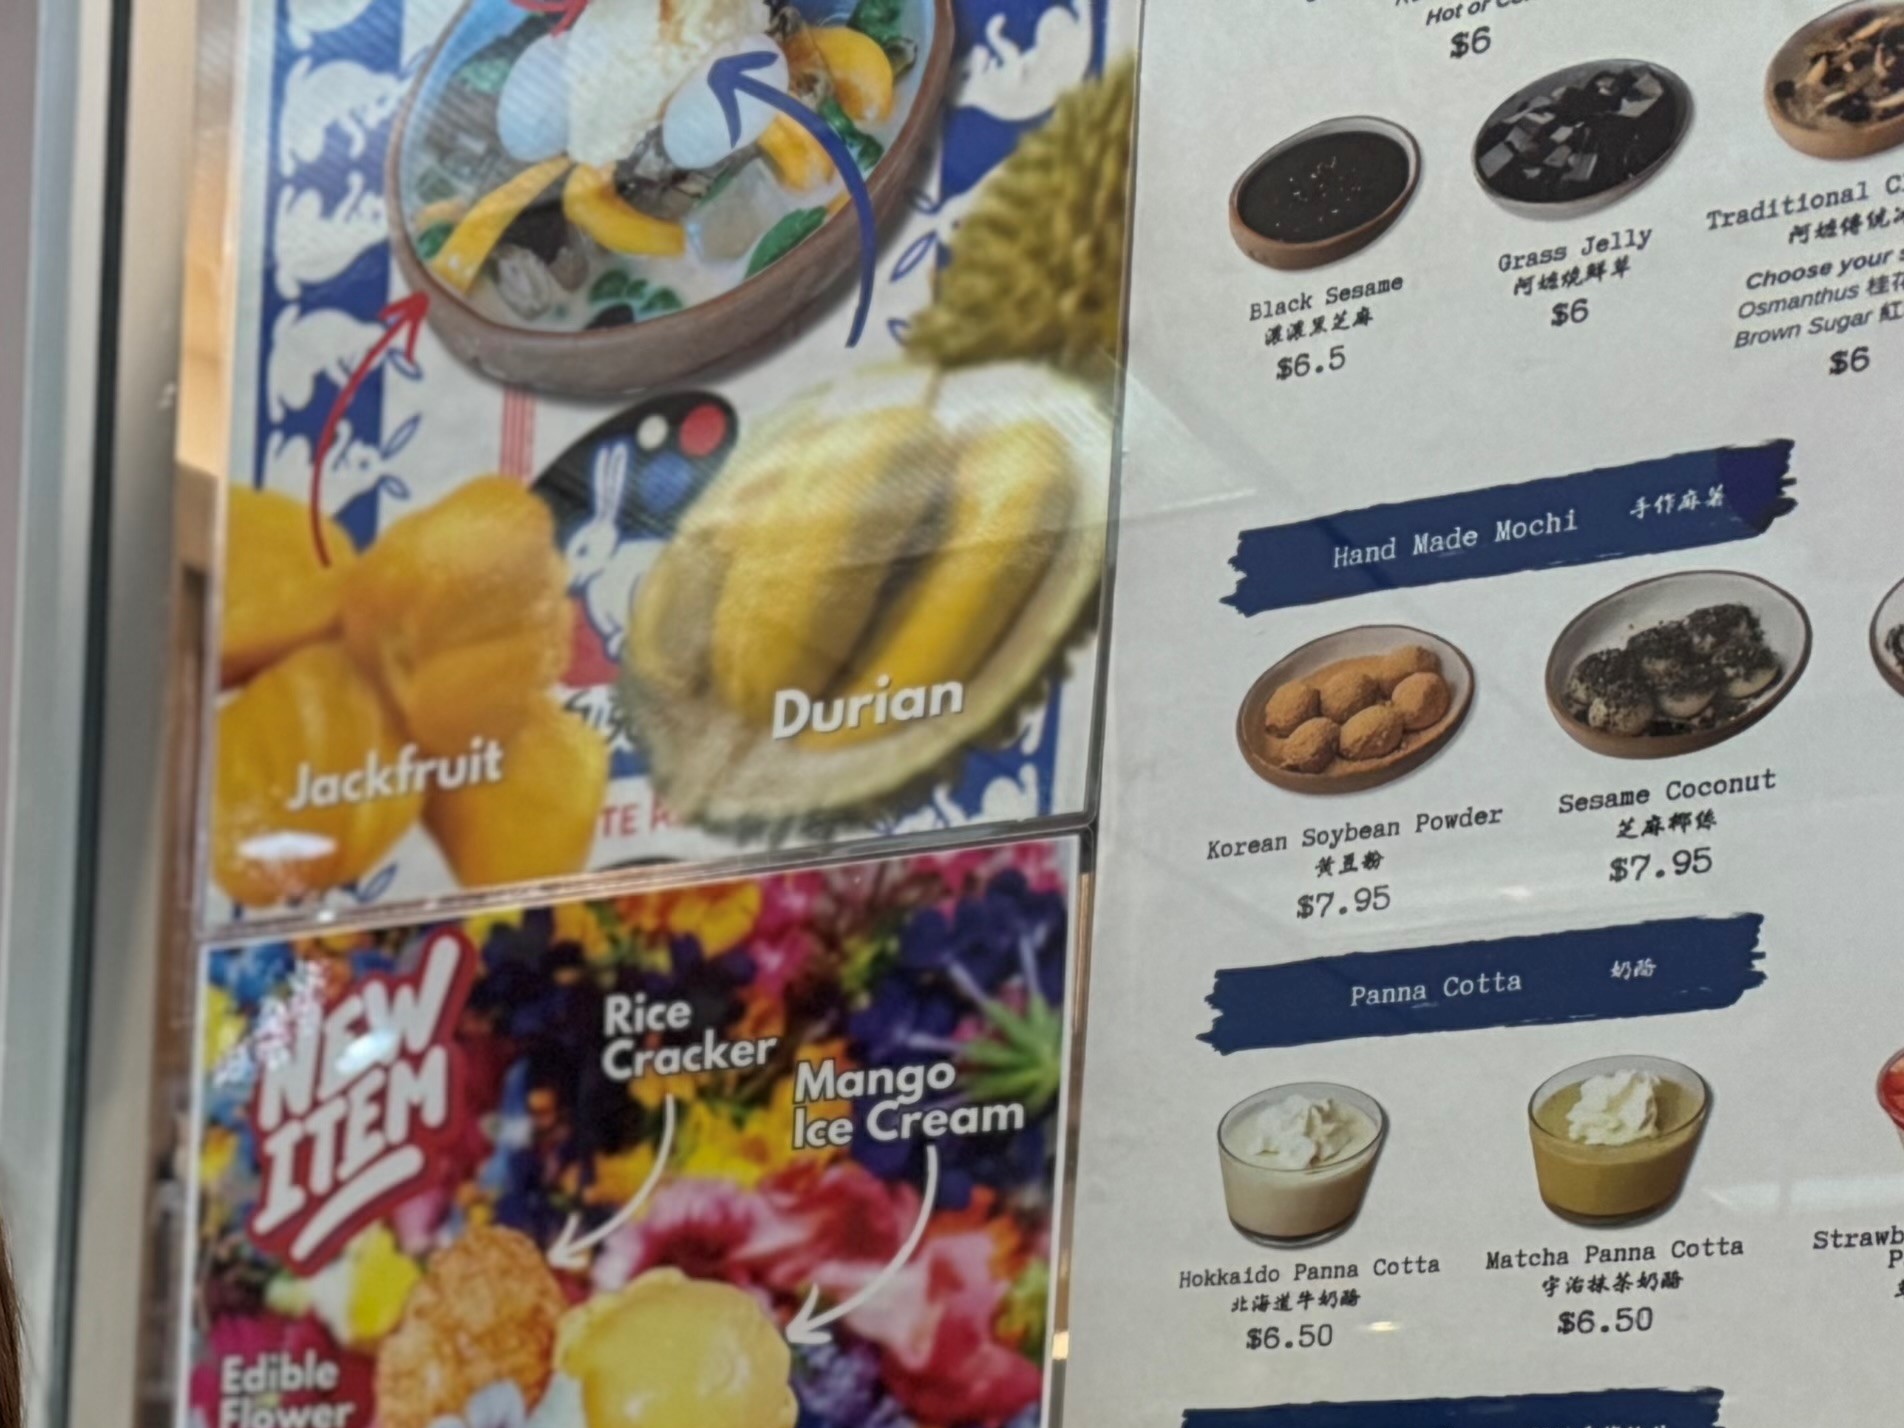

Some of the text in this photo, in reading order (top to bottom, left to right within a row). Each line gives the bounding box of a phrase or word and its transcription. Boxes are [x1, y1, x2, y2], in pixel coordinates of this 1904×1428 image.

[1425, 5, 1462, 26] Hot
[1450, 27, 1491, 58] $6
[1707, 181, 1869, 230] Traditional
[1498, 227, 1652, 273] Grass Jelly
[1745, 260, 1832, 291] Choose
[1835, 249, 1893, 276] your
[1249, 275, 1404, 322] Black Sesame
[1550, 298, 1589, 327] $6
[1737, 282, 1860, 320] Osmanthus
[1734, 309, 1874, 350] Brown Sugar
[1276, 345, 1346, 380] $6.5
[1829, 345, 1871, 375] $6
[1333, 508, 1579, 568] Hand Made Mochi
[772, 678, 966, 743] Durian
[288, 736, 506, 814] Jackfruit
[1558, 768, 1776, 814] Sesame Coconut
[1207, 806, 1503, 861] Korean Soybean Powder
[1609, 847, 1713, 883] $7.95
[1297, 885, 1391, 919] $7.95
[1350, 971, 1522, 1007] Panna Cotta
[257, 934, 461, 1132] NEW
[603, 992, 693, 1037] Rice
[602, 1031, 779, 1082] Cracker
[794, 1056, 957, 1112] Mango
[252, 1044, 450, 1235] ITEM
[794, 1096, 1026, 1151] Ice Cream
[1179, 1255, 1440, 1289] Hokkaido Panna Cotta
[1485, 1236, 1744, 1270] Matcha Panna Cotta
[1246, 1324, 1334, 1350] $6.50
[1557, 1306, 1654, 1335] $6.50
[220, 1354, 339, 1397] Edible
